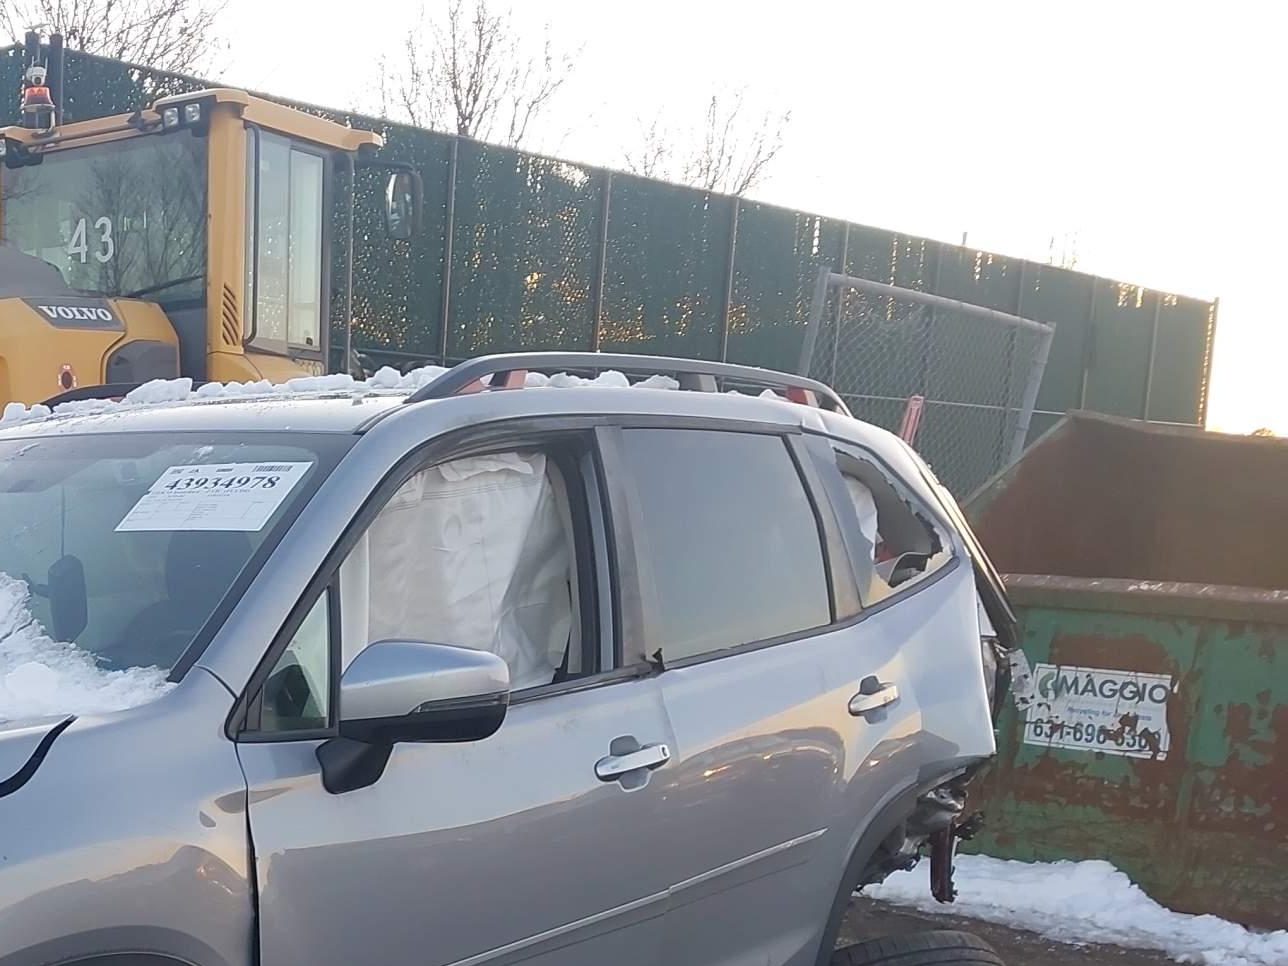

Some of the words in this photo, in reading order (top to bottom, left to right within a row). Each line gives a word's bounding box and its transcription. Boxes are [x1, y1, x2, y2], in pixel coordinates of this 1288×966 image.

[67, 216, 114, 264] 43
[37, 305, 112, 321] VOLVO
[165, 475, 281, 490] 43934978
[1060, 674, 1169, 704] MAGGIO
